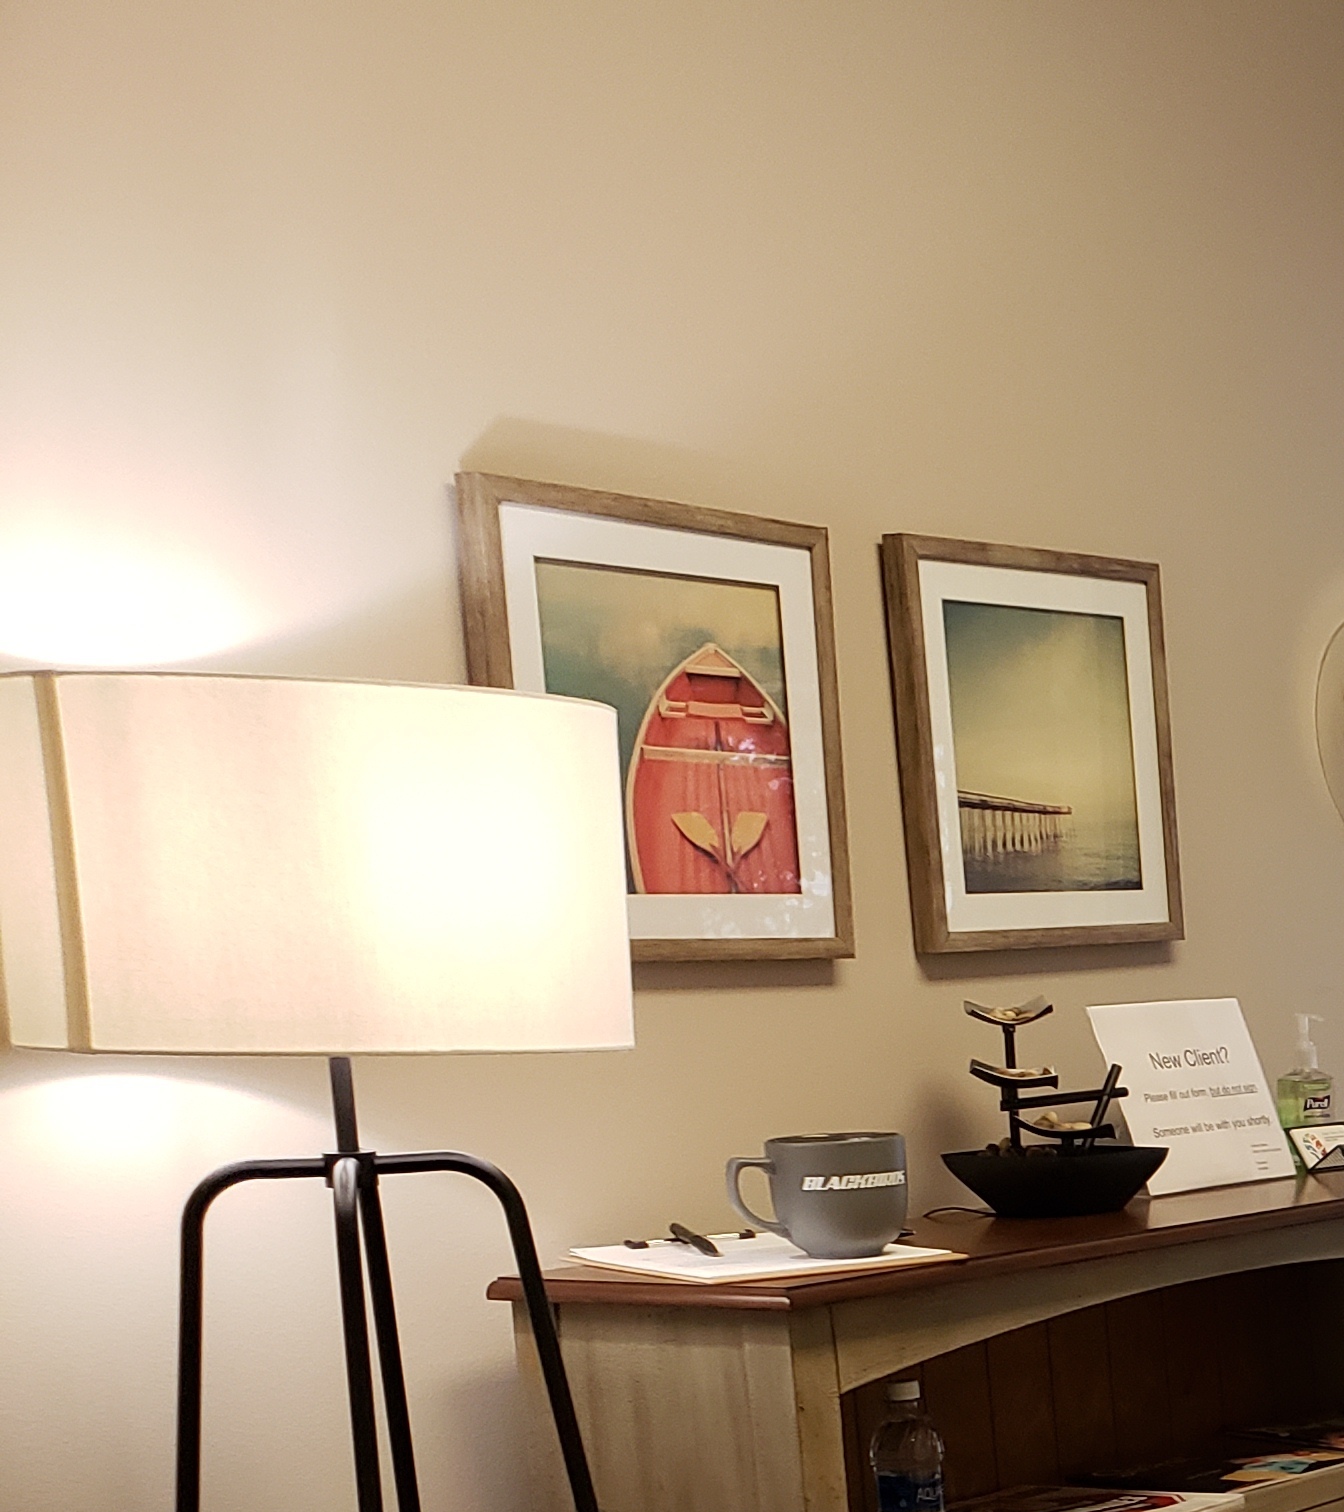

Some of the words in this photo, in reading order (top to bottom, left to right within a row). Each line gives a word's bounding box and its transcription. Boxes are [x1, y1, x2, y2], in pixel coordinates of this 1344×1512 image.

[1148, 1052, 1182, 1070] New
[1183, 1046, 1230, 1067] Client?
[1143, 1093, 1168, 1103] Please
[1169, 1090, 1177, 1100] fill
[1179, 1089, 1190, 1099] out
[1209, 1086, 1220, 1096] but
[1222, 1085, 1231, 1094] do
[1153, 1127, 1190, 1138] Someone
[1190, 1122, 1203, 1133] will
[1203, 1122, 1215, 1132] be
[1215, 1119, 1230, 1130] with
[1231, 1119, 1246, 1130] you
